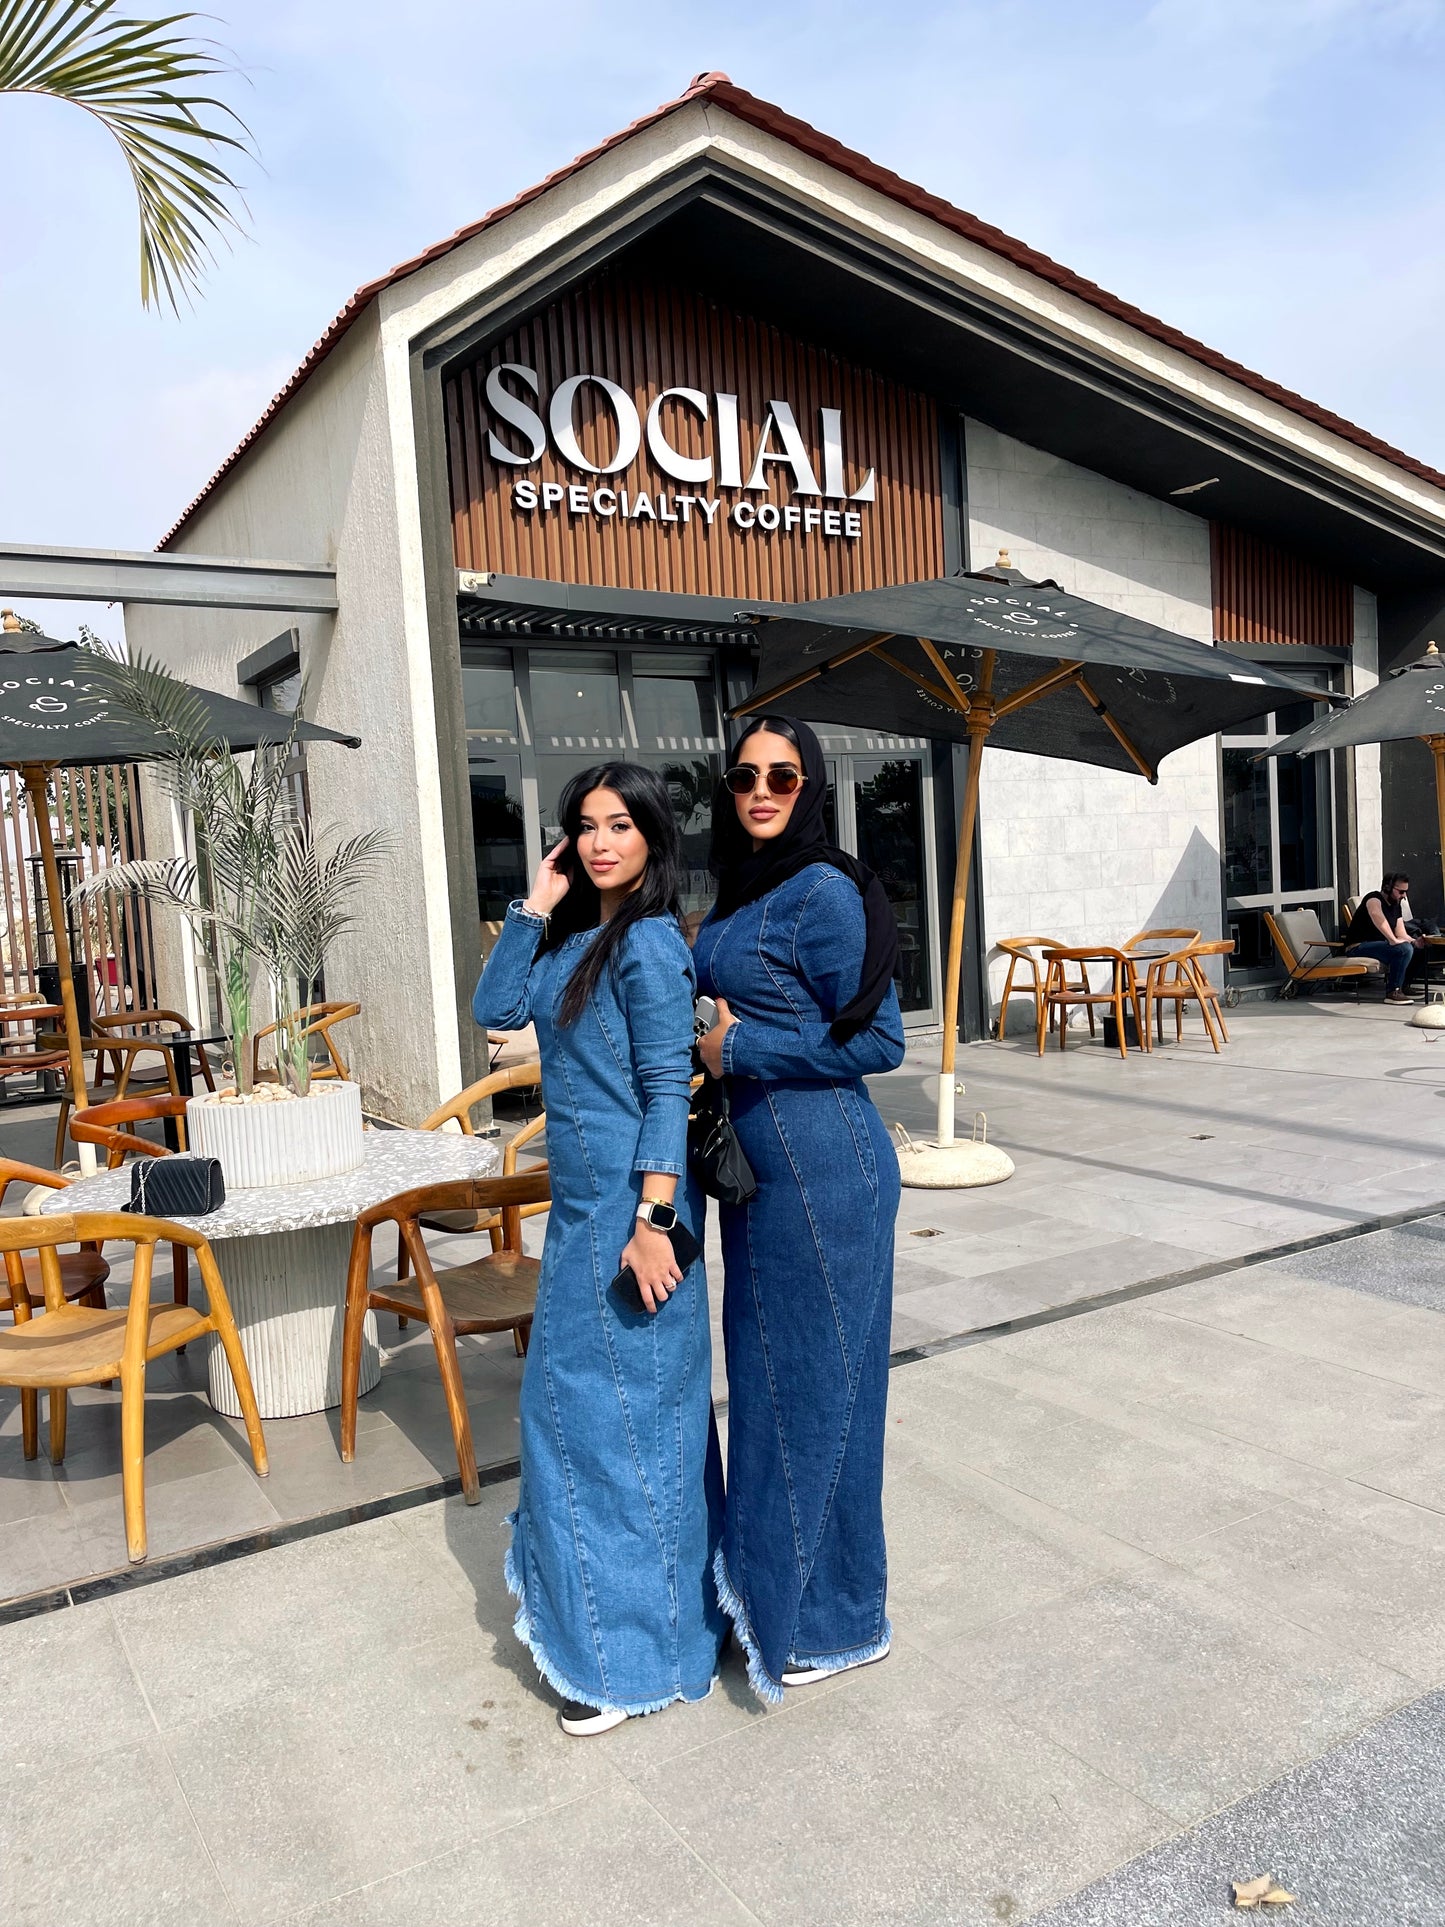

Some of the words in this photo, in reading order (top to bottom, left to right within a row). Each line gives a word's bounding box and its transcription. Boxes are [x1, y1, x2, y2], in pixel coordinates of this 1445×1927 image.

[486, 363, 876, 503] SOCIAL
[513, 479, 721, 524] SPECIALTY
[732, 501, 862, 538] COFFEE
[969, 596, 1067, 617] SOCIAL
[974, 617, 1036, 638] SPECIALTY
[1, 715, 70, 730] SPECIALTY
